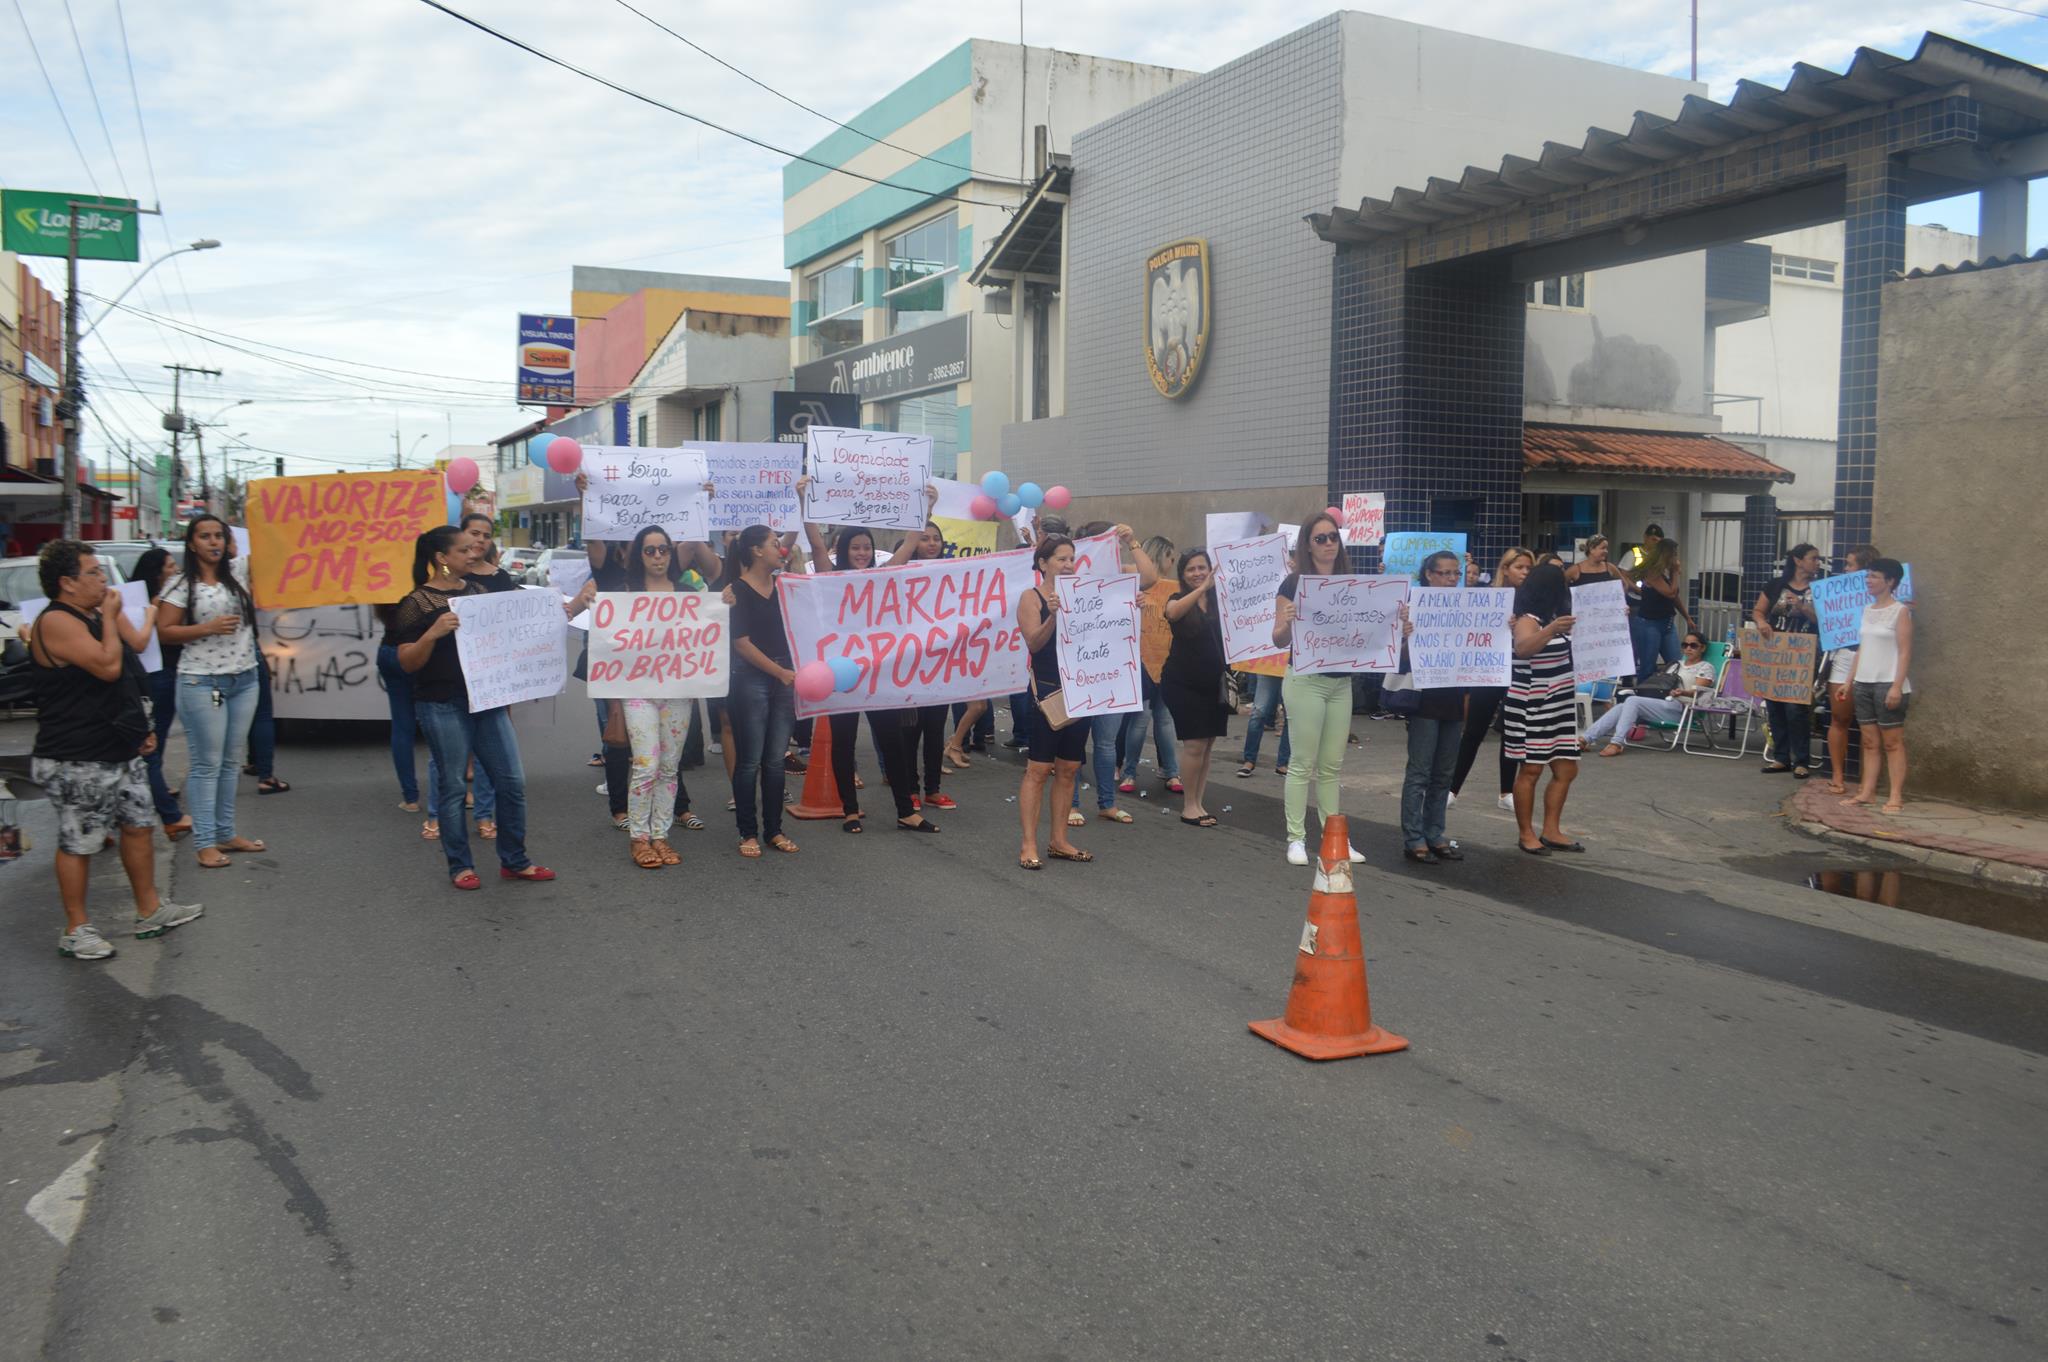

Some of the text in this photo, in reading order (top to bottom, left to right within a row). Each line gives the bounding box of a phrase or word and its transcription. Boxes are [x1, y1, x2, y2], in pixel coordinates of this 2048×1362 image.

[521, 329, 548, 339] VISUAL
[852, 344, 914, 381] ambience
[603, 465, 621, 481] #
[759, 470, 792, 485] PMES
[260, 479, 438, 524] VALORIZE
[600, 494, 642, 514] para
[731, 489, 753, 499] sem
[779, 503, 798, 519] que
[297, 519, 423, 549] NOSSOS
[277, 545, 392, 594] PM's
[838, 568, 1008, 627] MARCHA
[1813, 574, 1866, 600] O POLICI
[1073, 596, 1104, 614] Não
[1428, 592, 1461, 608] MENOR
[1467, 592, 1490, 608] TAXA
[1496, 592, 1508, 608] DE
[460, 596, 558, 636] GOVERNADOR
[595, 595, 702, 629] O PIOR
[1474, 612, 1489, 628] EM
[1489, 612, 1505, 628] 23
[508, 621, 556, 643] MERECE
[611, 620, 721, 652] SALÁRIO
[995, 625, 1022, 652] DE
[1414, 632, 1440, 648] ANOS
[1455, 633, 1463, 648] O
[1465, 632, 1492, 648] PIOR
[1077, 641, 1111, 662] tanto
[1460, 651, 1473, 667] DO
[1474, 651, 1509, 667] BRASIL
[589, 650, 718, 684] DO BRASIL
